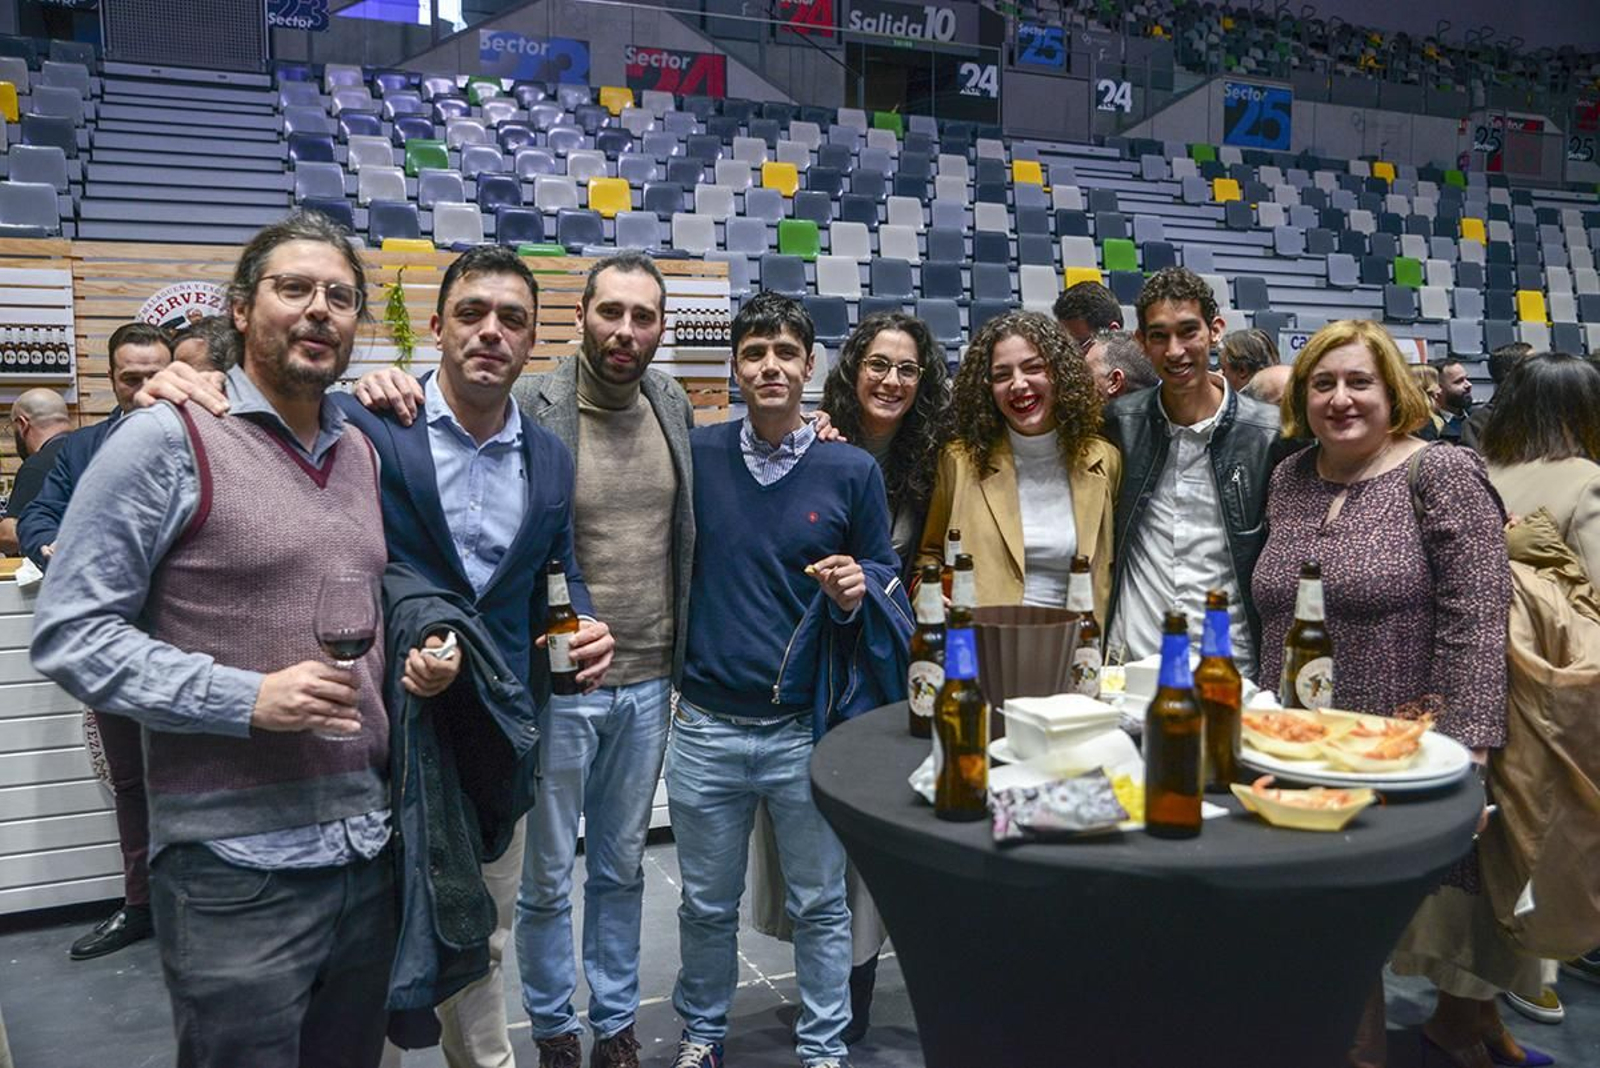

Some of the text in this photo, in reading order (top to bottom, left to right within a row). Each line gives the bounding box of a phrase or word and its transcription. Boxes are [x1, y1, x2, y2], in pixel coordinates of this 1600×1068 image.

[268, 12, 314, 28] Sector
[850, 5, 956, 42] Salida 10
[480, 33, 550, 56] Sector
[625, 46, 691, 69] Sector
[1019, 25, 1066, 69] 25
[959, 62, 998, 98] 24
[1224, 83, 1268, 102] Sector
[1097, 79, 1132, 113] 24
[1224, 84, 1292, 151] 25
[1475, 126, 1502, 153] 25
[1569, 135, 1594, 162] 25
[147, 291, 225, 327] CERVEZ
